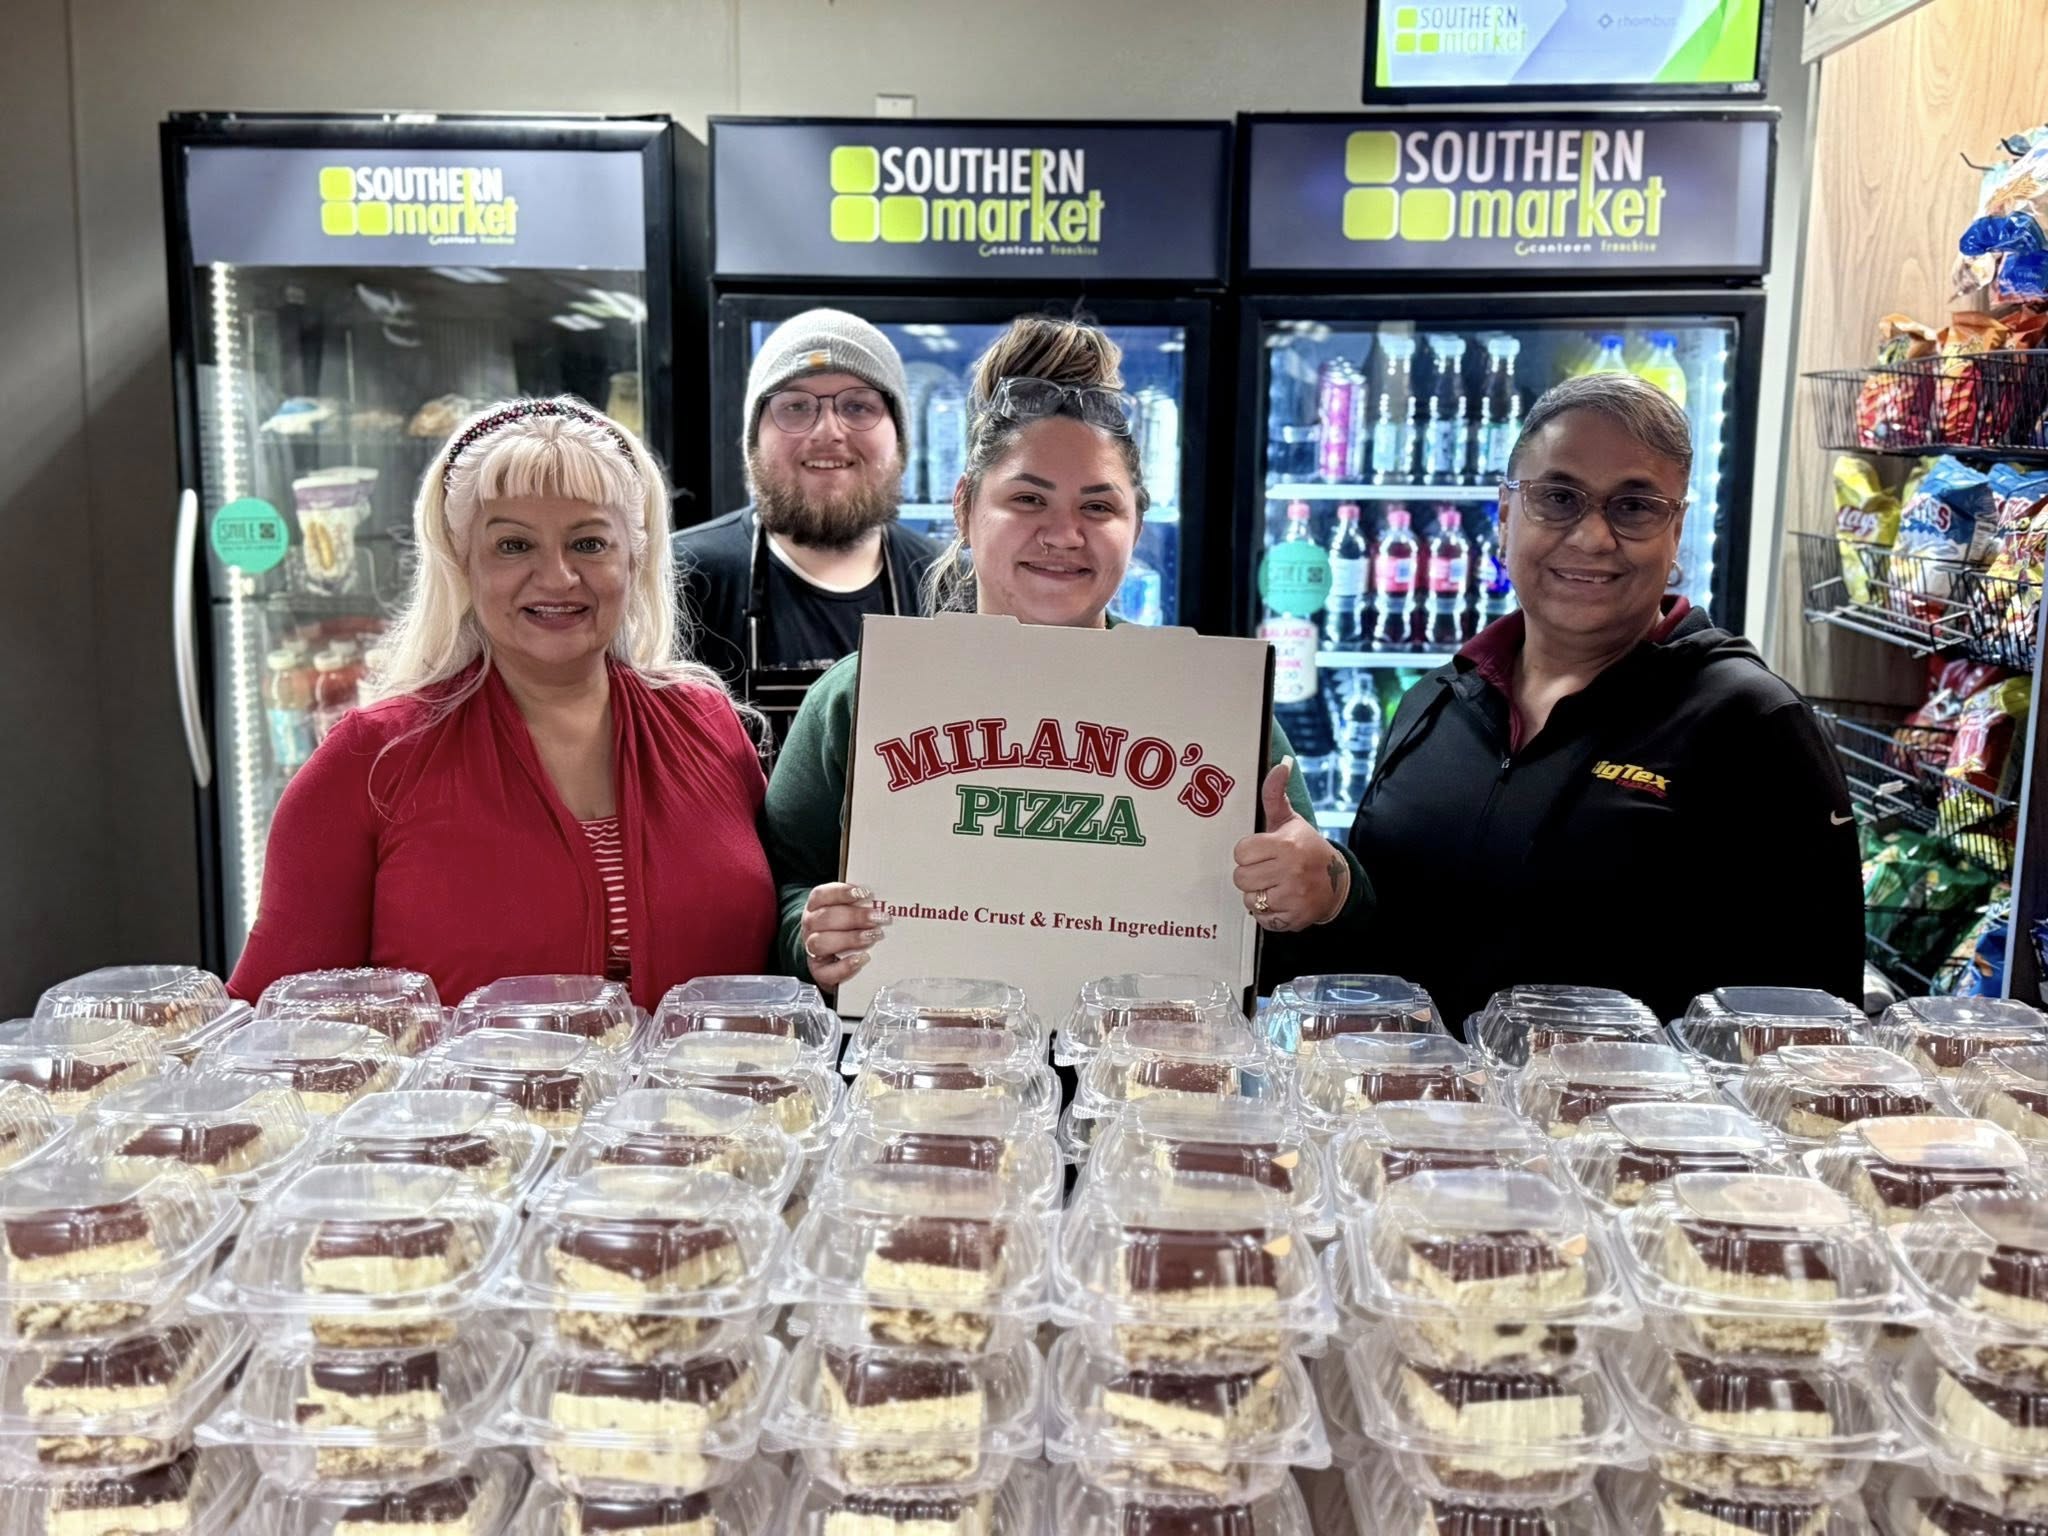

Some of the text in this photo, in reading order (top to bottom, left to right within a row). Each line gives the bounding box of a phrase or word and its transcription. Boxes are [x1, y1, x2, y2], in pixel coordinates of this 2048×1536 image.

[1420, 7, 1518, 28] SOUTHERN
[1443, 10, 1527, 54] market
[881, 146, 1084, 194] SOUTHERN
[1405, 130, 1644, 184] SOUTHERN
[356, 166, 503, 201] SOUTHERN
[394, 168, 518, 235] market
[931, 149, 1105, 242] market
[1459, 131, 1666, 238] market
[952, 785, 1146, 847] PIZZA
[974, 907, 1025, 925] Crust
[1030, 911, 1047, 927] &
[1052, 913, 1103, 931] Fresh
[1108, 917, 1218, 939] Ingredients!
